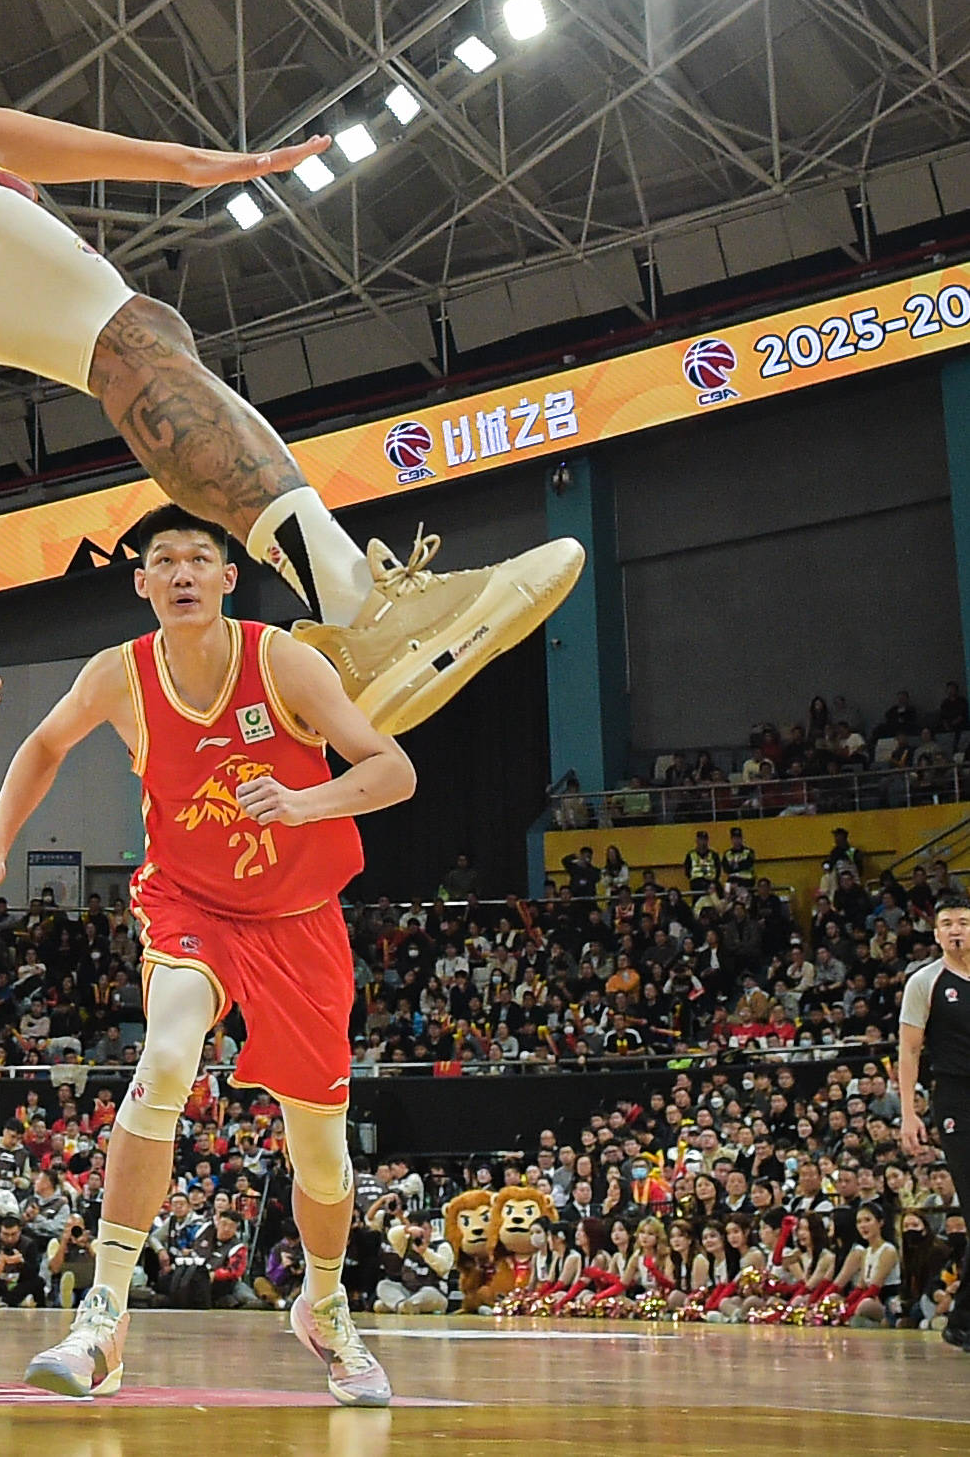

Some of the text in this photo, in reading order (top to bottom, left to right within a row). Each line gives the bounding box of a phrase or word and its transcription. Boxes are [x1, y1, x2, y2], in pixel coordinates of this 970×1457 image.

[698, 388, 740, 406] CBA
[441, 390, 579, 468] 以城之名
[396, 466, 436, 485] CBA
[228, 827, 278, 879] 21
